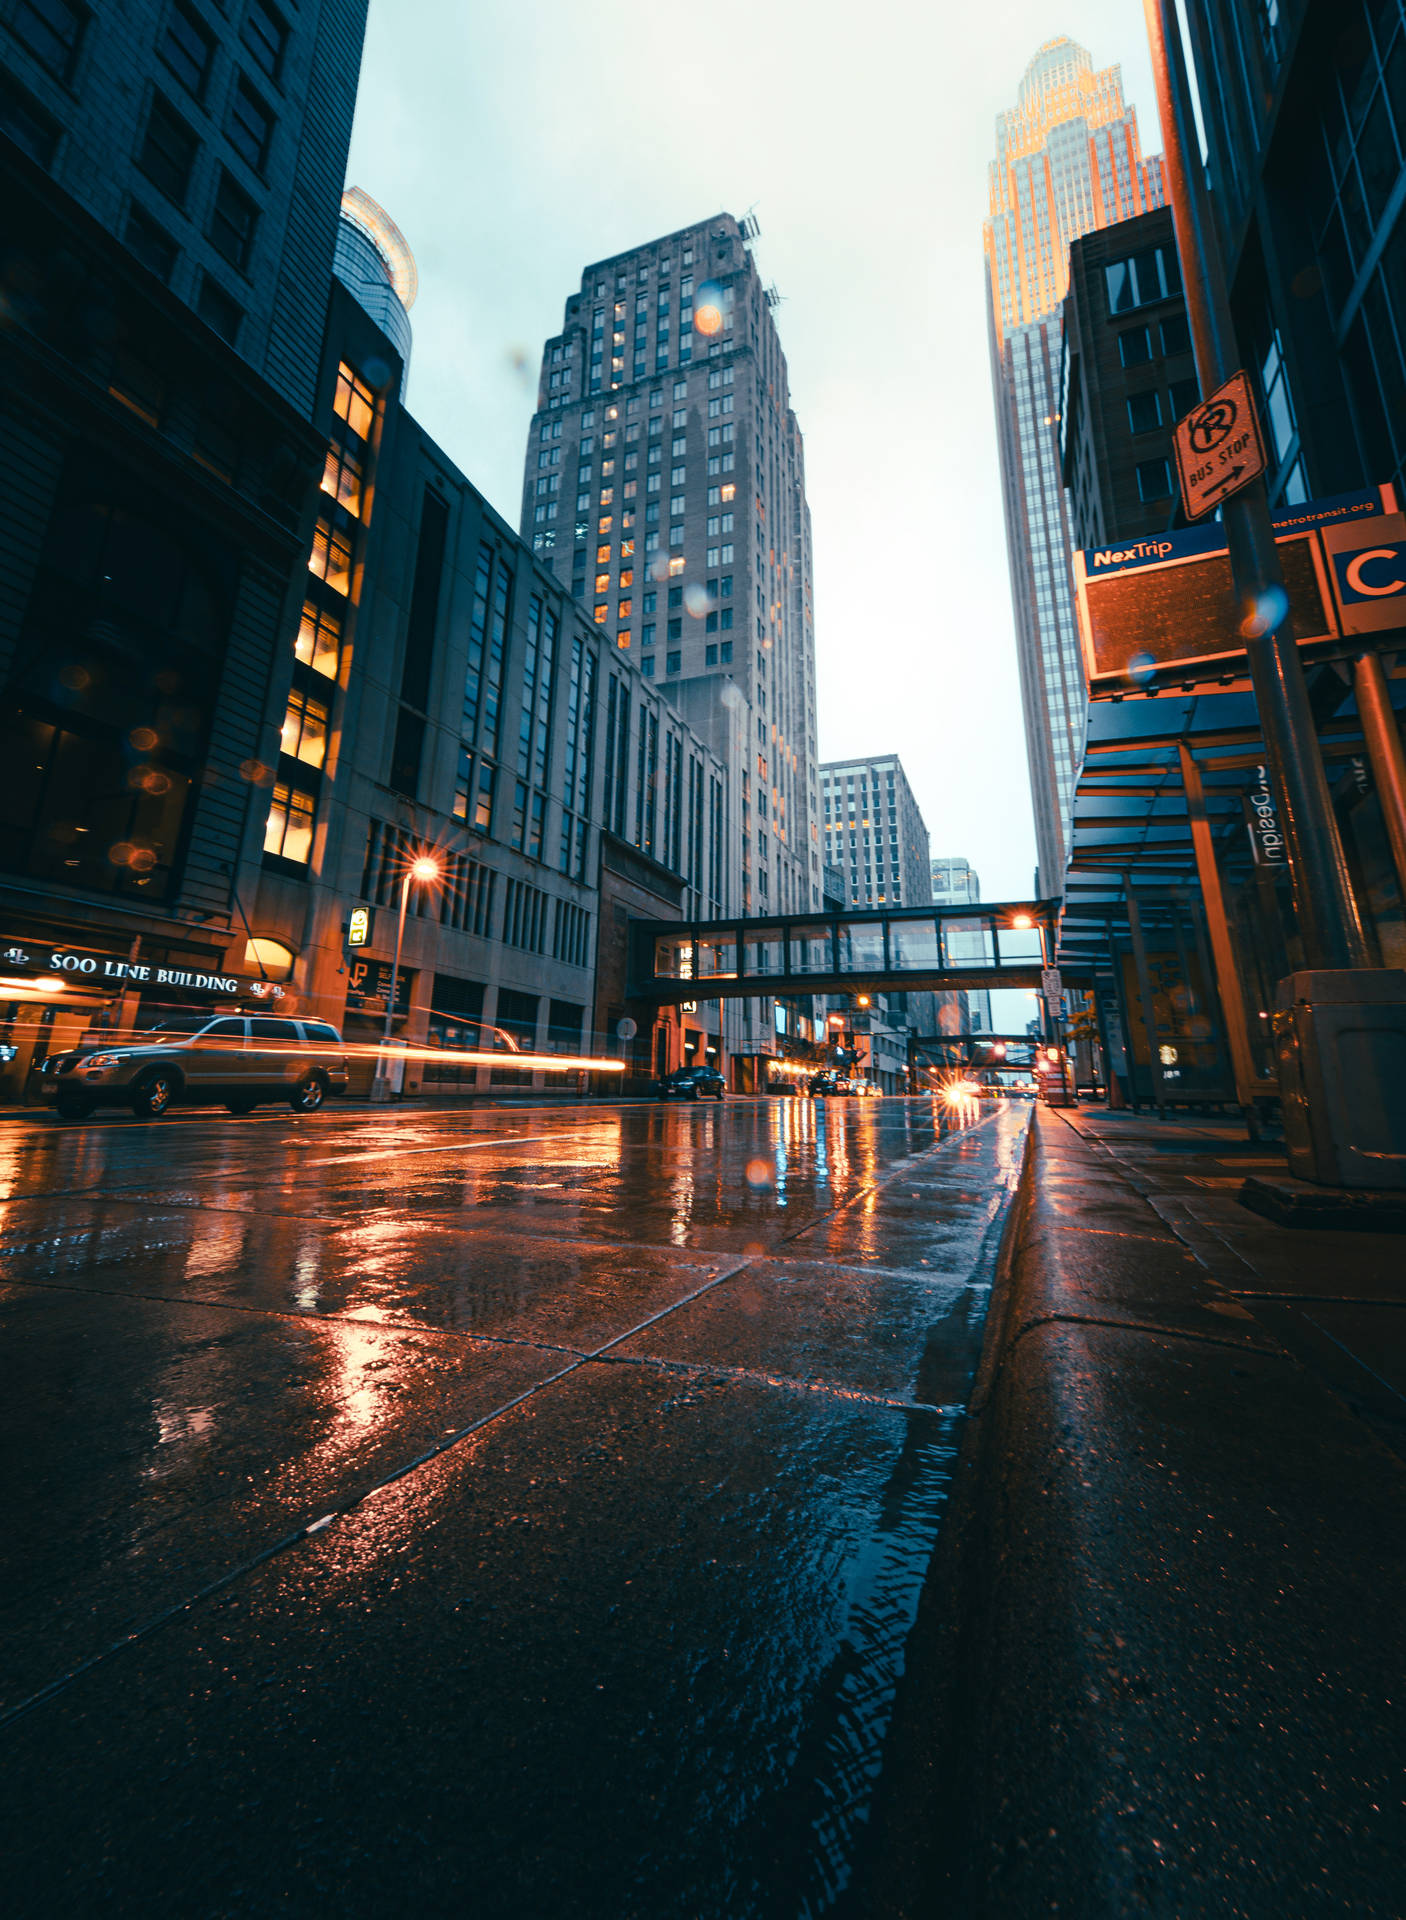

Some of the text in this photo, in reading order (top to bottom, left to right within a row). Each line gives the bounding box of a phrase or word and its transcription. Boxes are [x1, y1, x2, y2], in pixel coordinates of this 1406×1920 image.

[1189, 432, 1250, 488] BUS STOP
[1093, 541, 1173, 568] NexTrip
[1345, 549, 1406, 596] C
[49, 953, 97, 974] SOO
[103, 960, 151, 982] LINE
[156, 969, 239, 993] BUILDING
